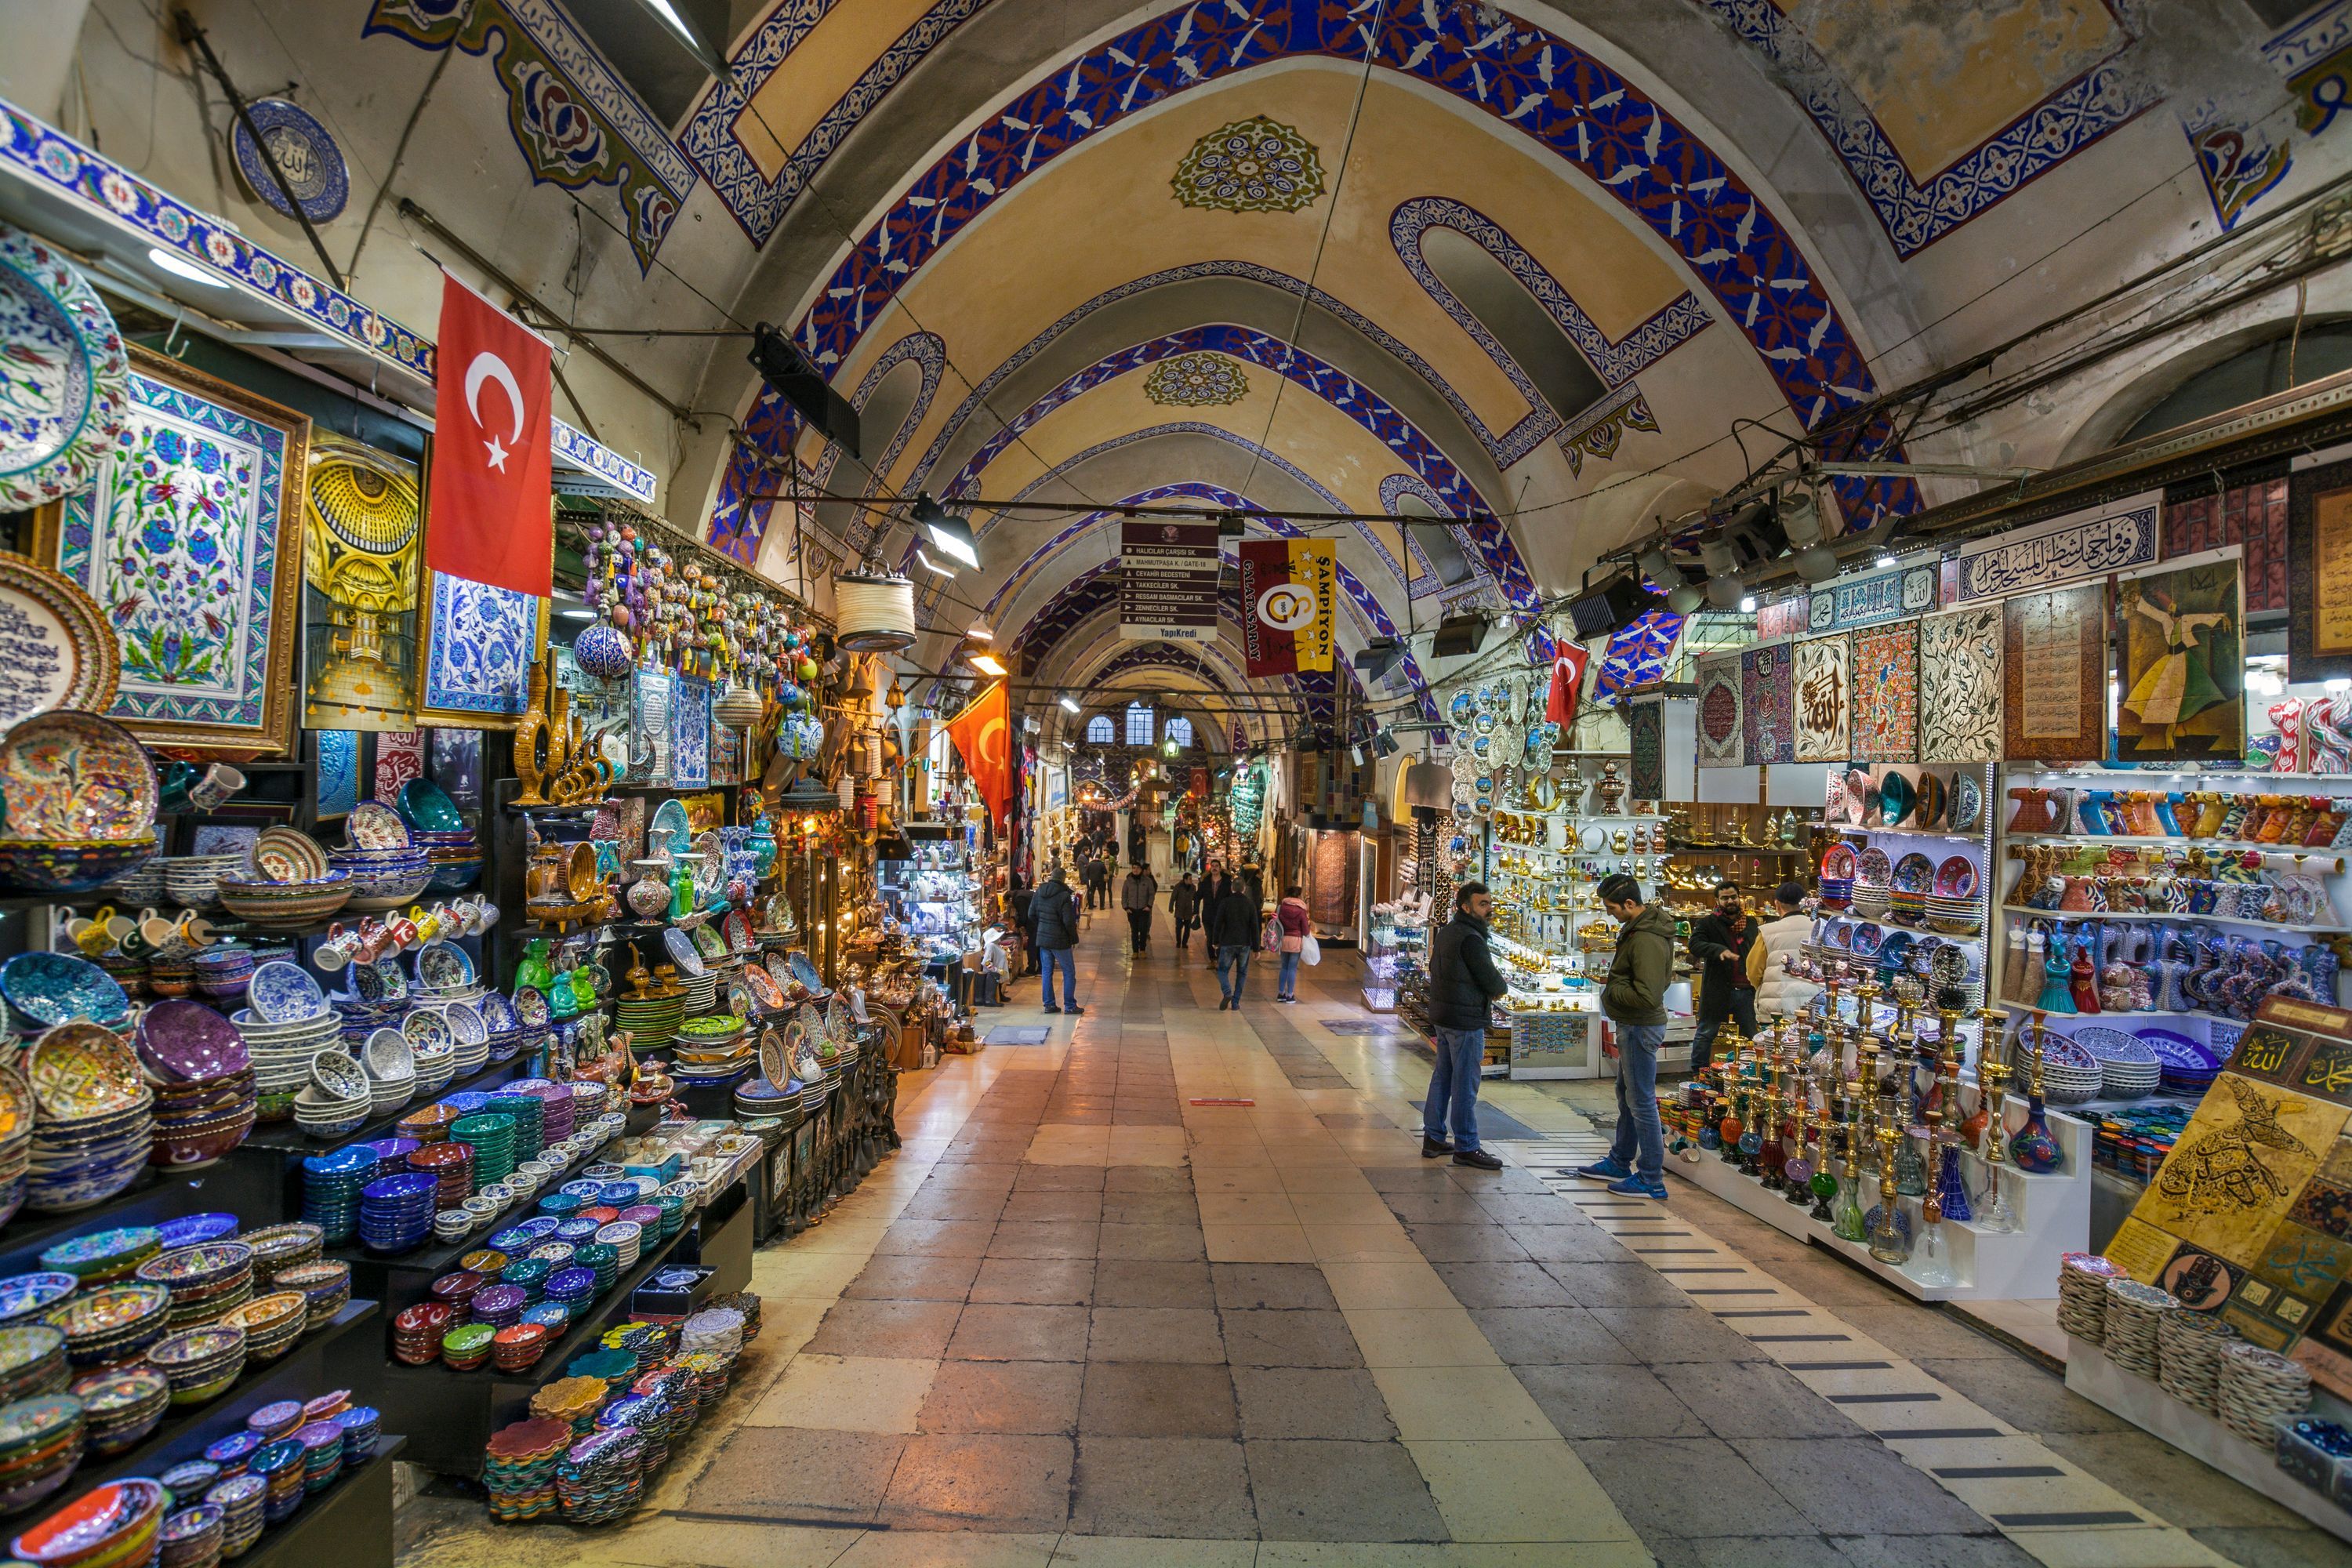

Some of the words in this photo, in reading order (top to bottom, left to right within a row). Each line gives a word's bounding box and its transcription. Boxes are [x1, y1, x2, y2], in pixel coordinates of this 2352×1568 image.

[1136, 558, 1174, 568] MAHMUTPAŞA
[1135, 569, 1160, 578] CEVAHİR
[1135, 581, 1169, 590] TAKKECİLER
[1135, 604, 1169, 612] ZENNECİLER
[1243, 559, 1261, 662] GALATASARAY
[1316, 556, 1331, 656] ŞAMPİYON
[1160, 628, 1197, 639] YapıKredi
